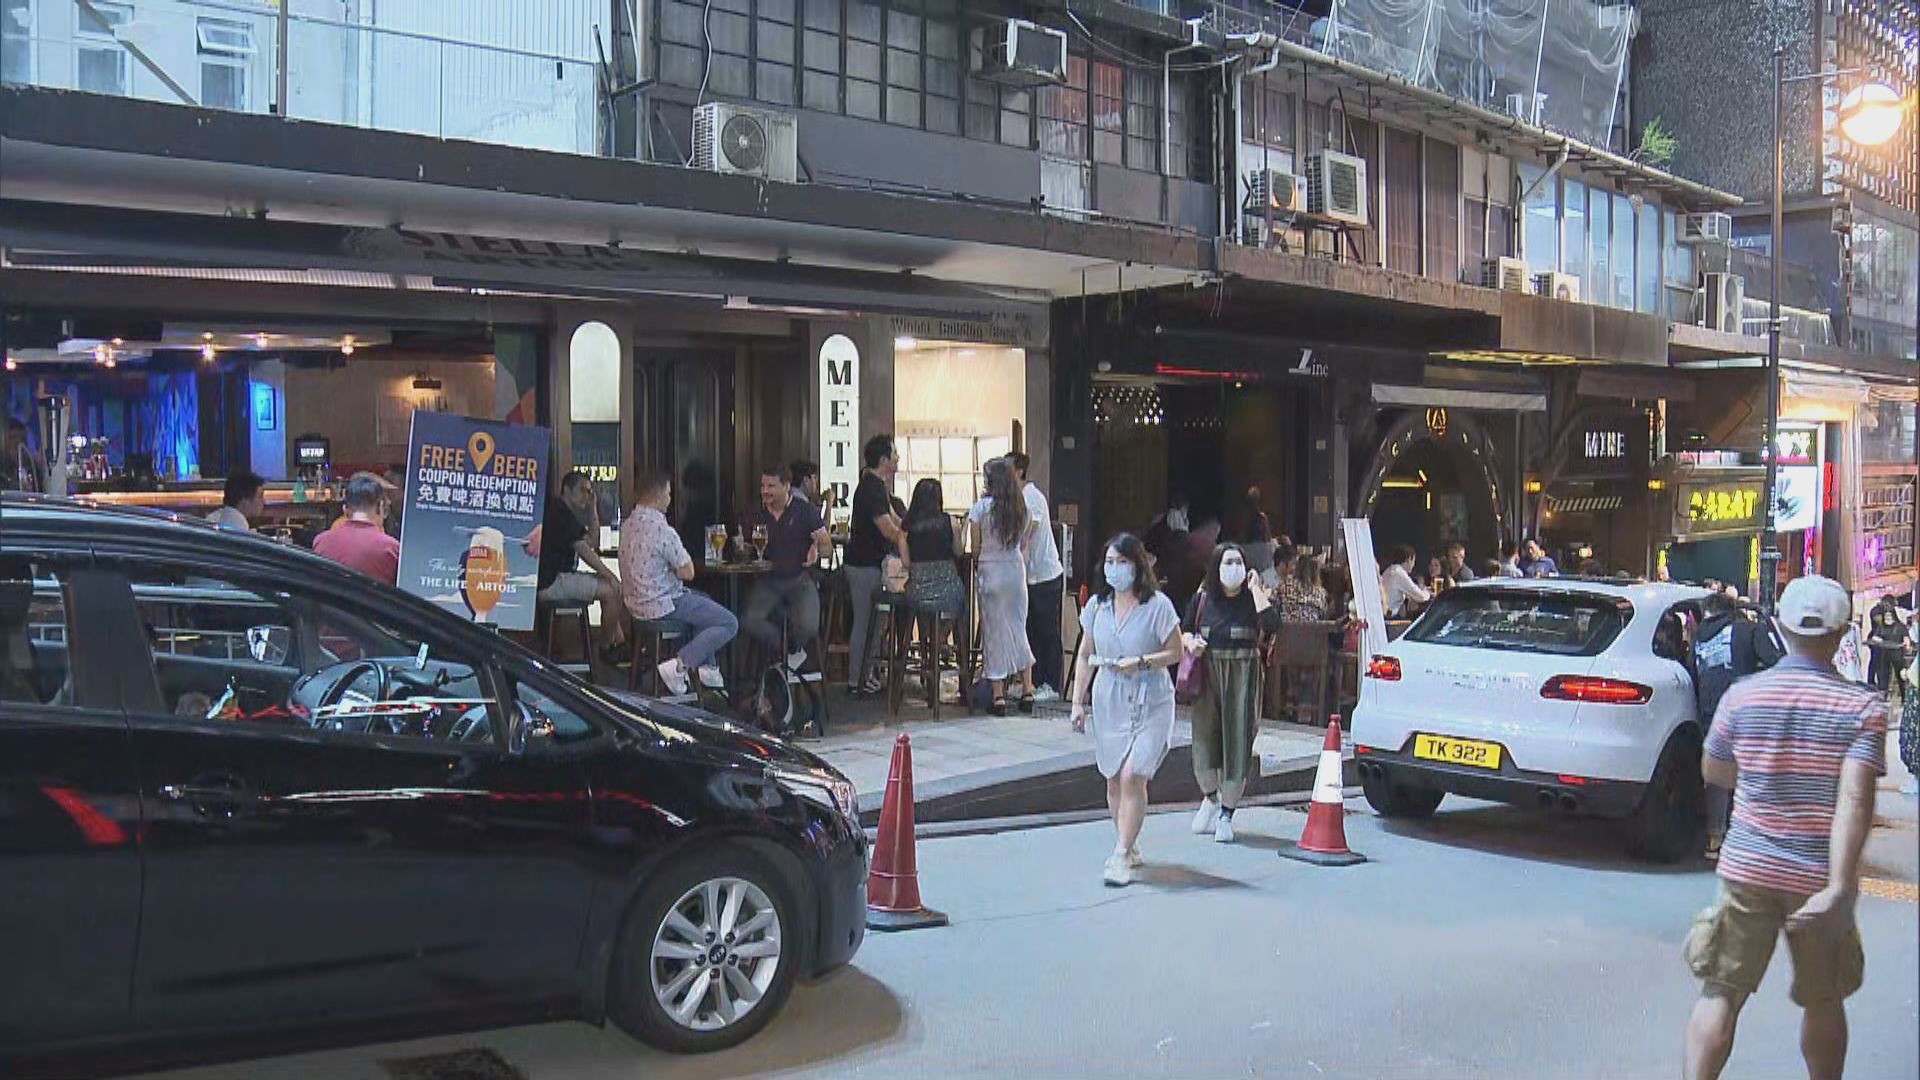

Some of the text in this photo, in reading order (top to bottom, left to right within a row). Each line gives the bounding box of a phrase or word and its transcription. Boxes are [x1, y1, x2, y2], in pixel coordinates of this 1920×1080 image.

[1289, 349, 1329, 376] Zinc
[421, 444, 538, 480] FREE BEER
[419, 468, 537, 496] COUPON REDEMPTION
[416, 484, 535, 514] 免費啤酒換領點
[420, 576, 517, 593] THE LIFE ARTOIS
[1427, 740, 1487, 762] TK 322
